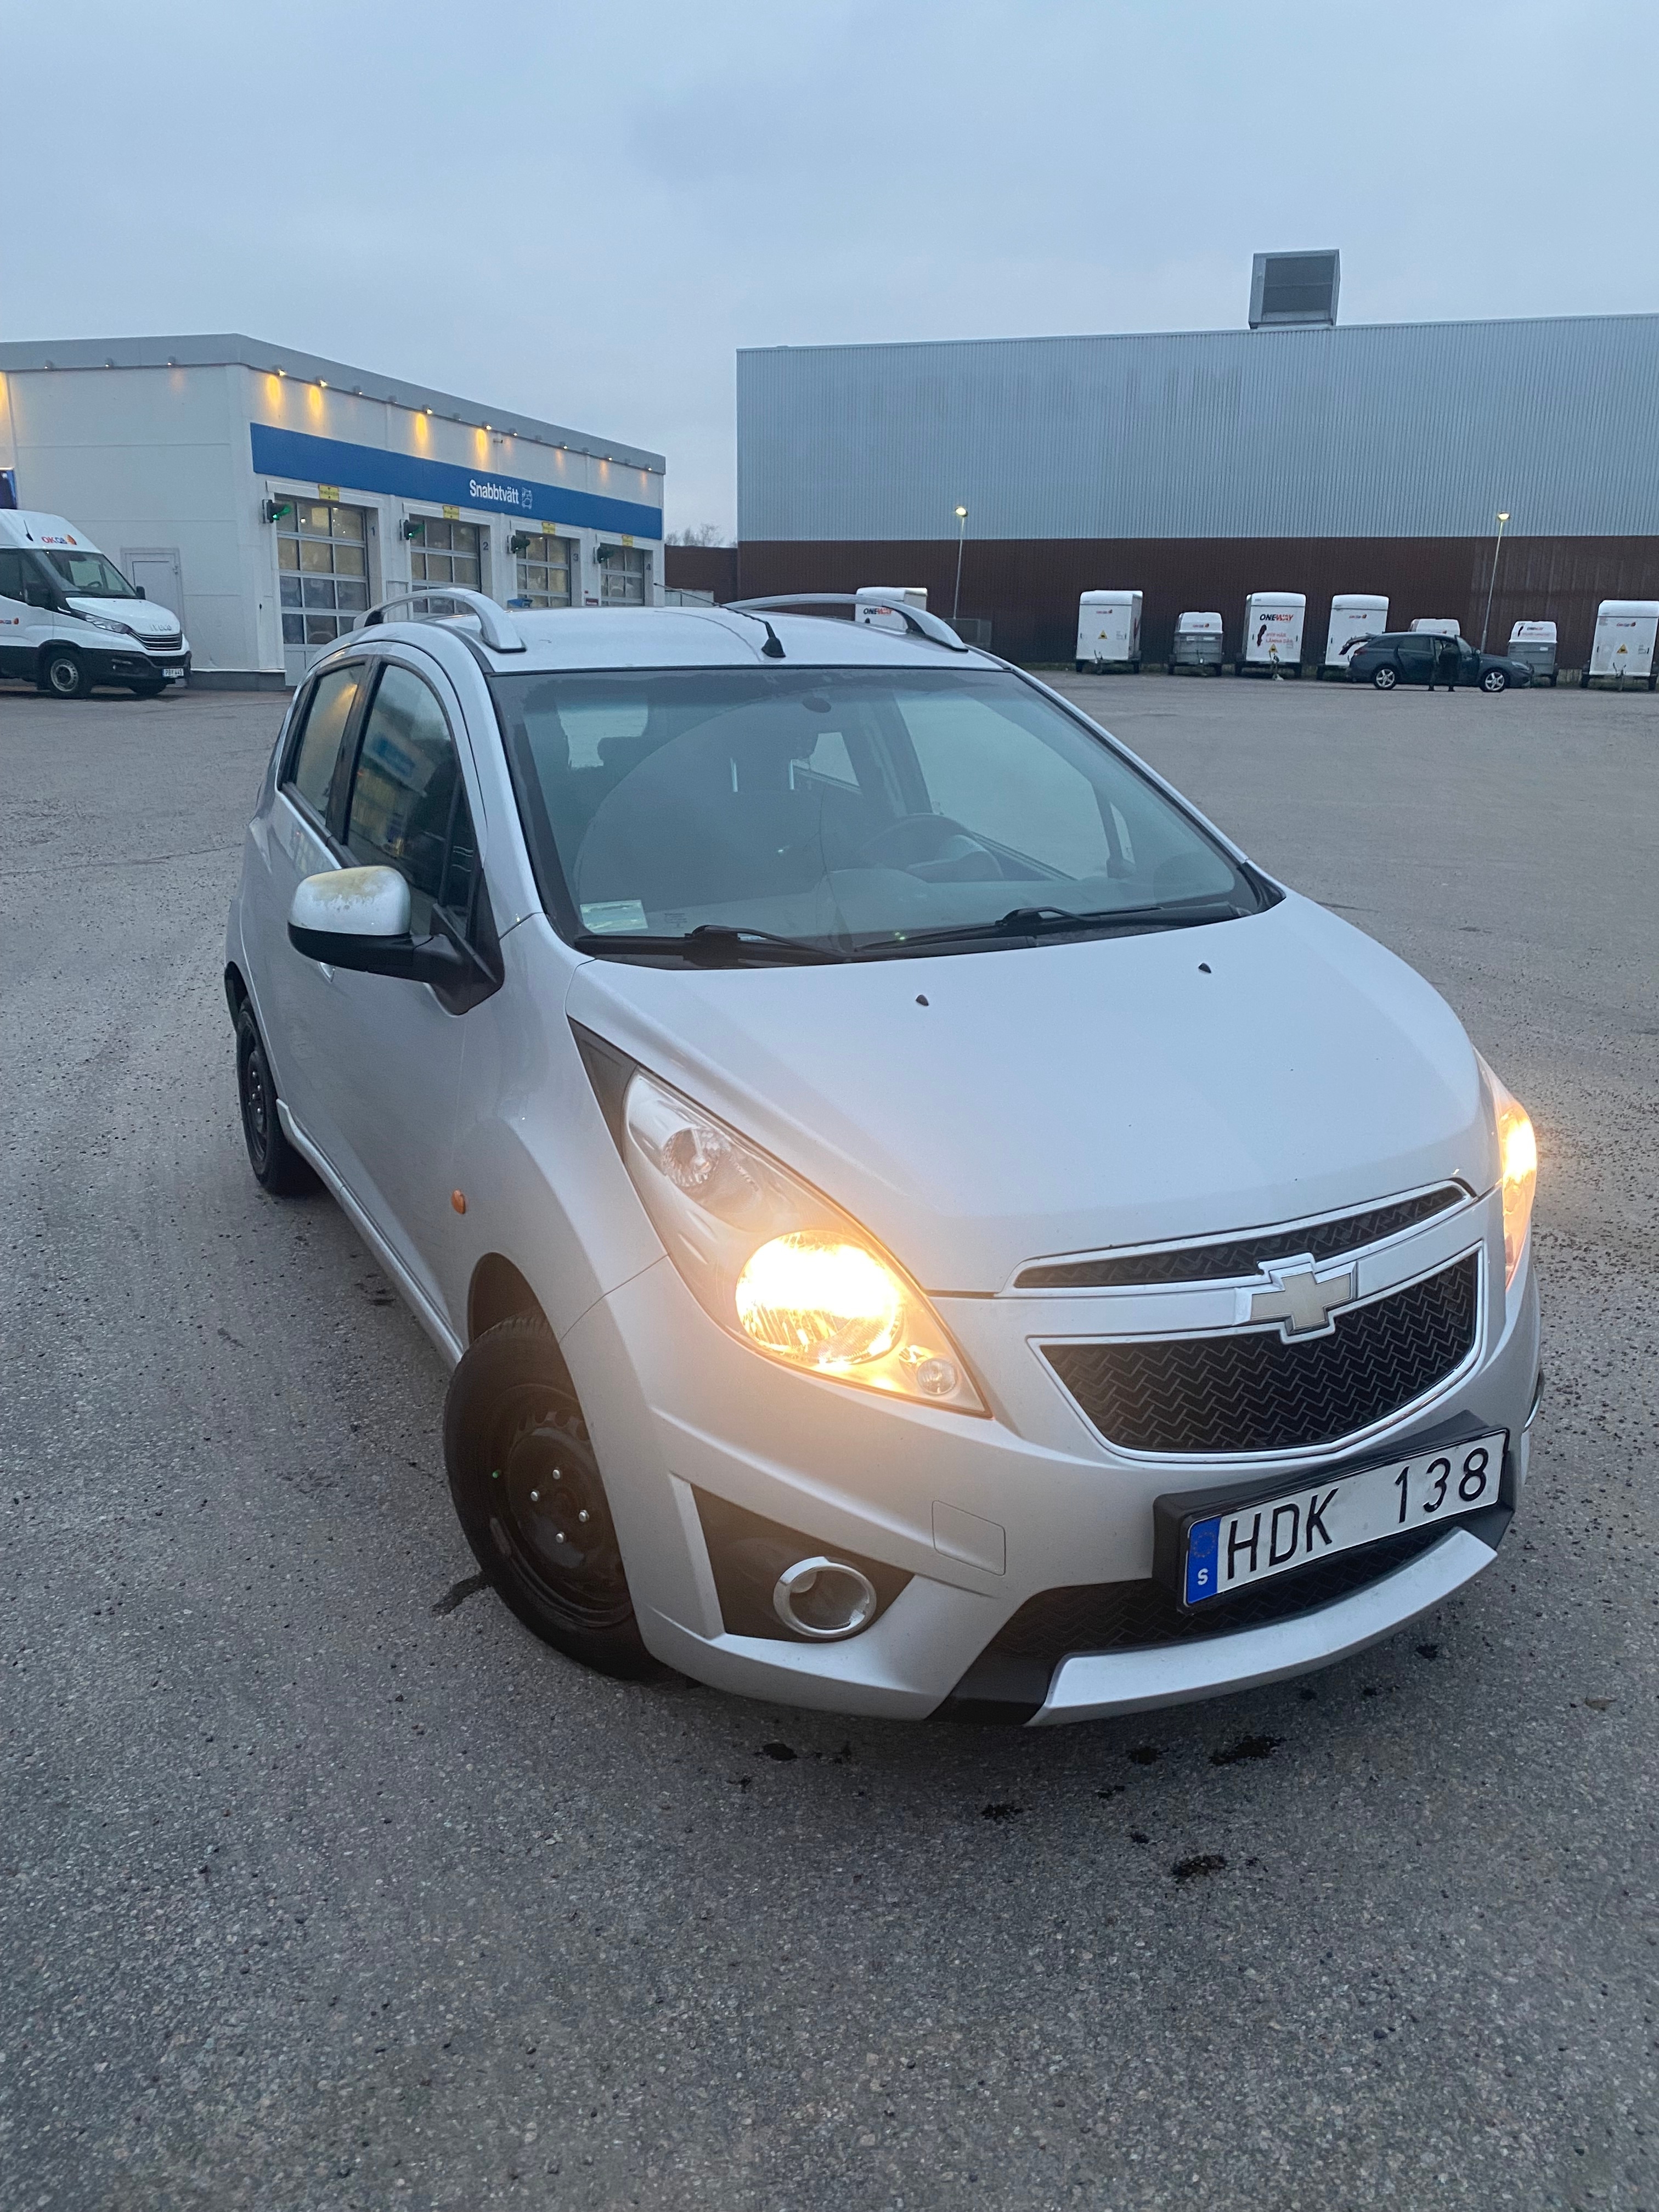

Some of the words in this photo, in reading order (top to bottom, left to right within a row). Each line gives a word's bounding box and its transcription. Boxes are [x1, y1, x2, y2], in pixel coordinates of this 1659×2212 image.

[469, 479, 519, 504] Snabbtvätt
[371, 526, 375, 536] 1
[482, 541, 489, 550] 2
[573, 553, 579, 562] 3
[1227, 1487, 1339, 1581] HDK
[1394, 1447, 1489, 1523] 138
[1197, 1568, 1209, 1585] S
